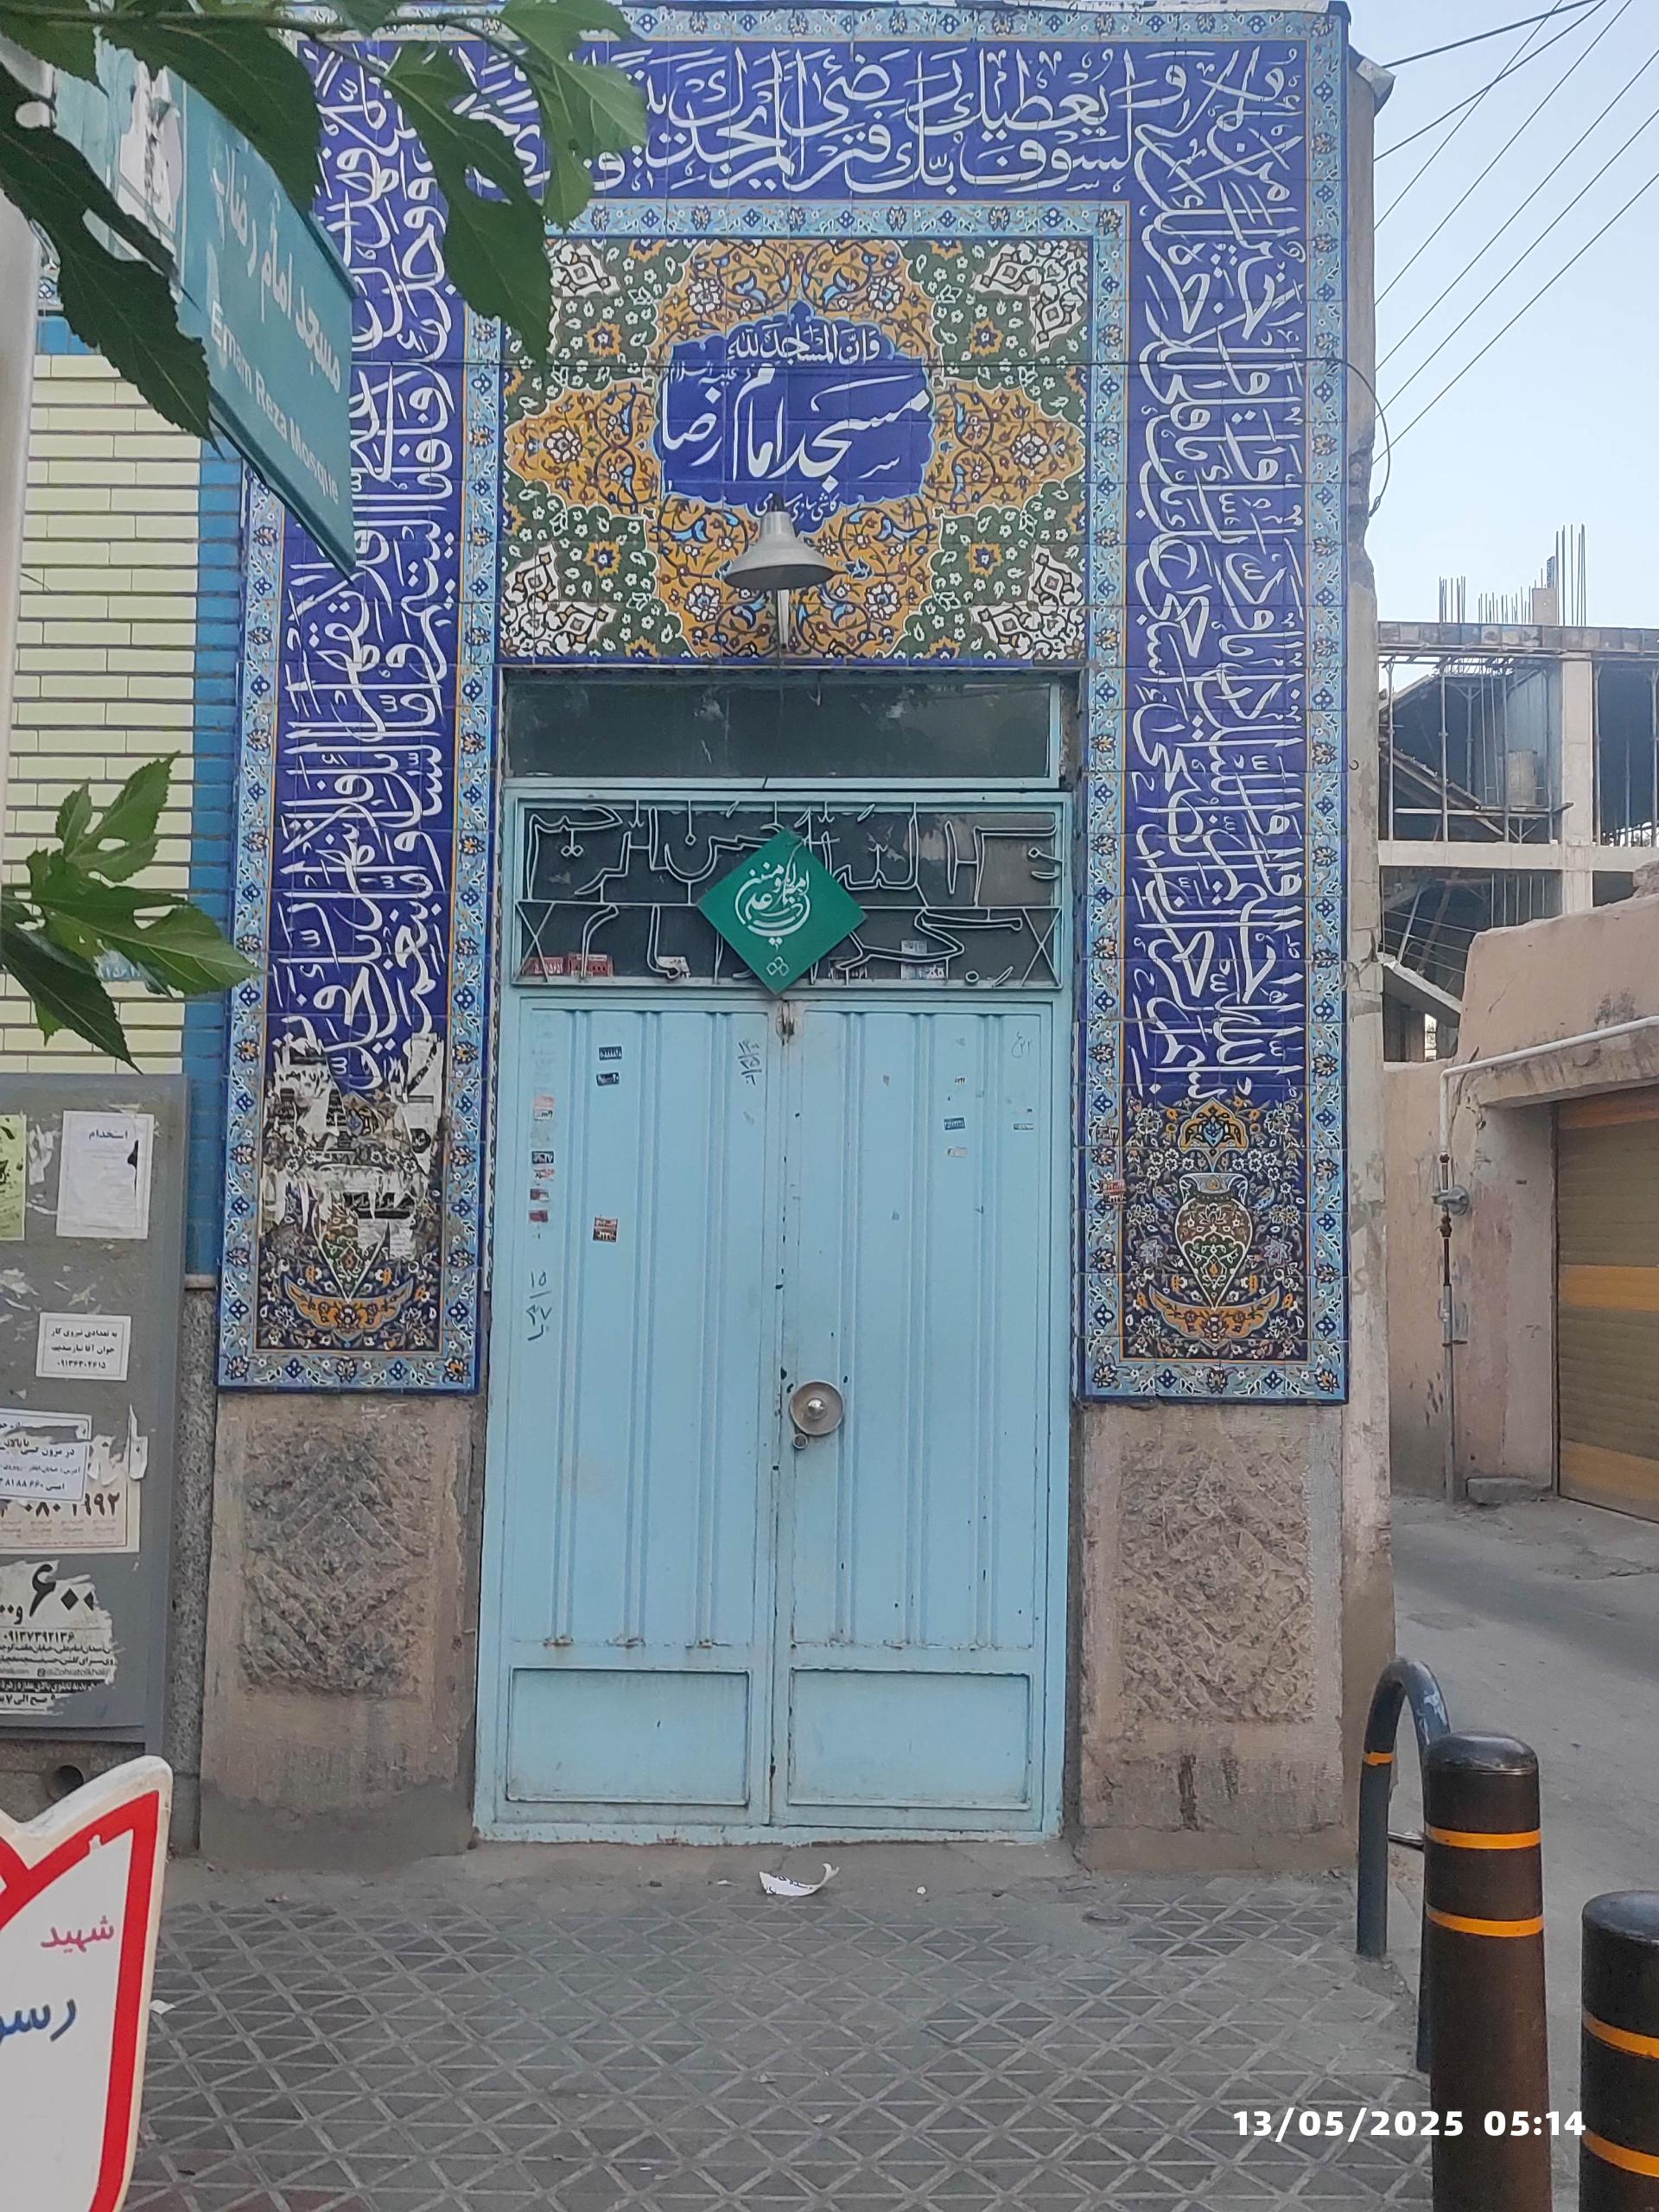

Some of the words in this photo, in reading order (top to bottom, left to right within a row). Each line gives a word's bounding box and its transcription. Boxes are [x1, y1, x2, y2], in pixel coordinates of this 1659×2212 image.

[211, 300, 252, 395] Emam
[255, 370, 289, 442] Reza
[289, 418, 339, 505] Mosque
[40, 1915, 115, 1954] شهید
